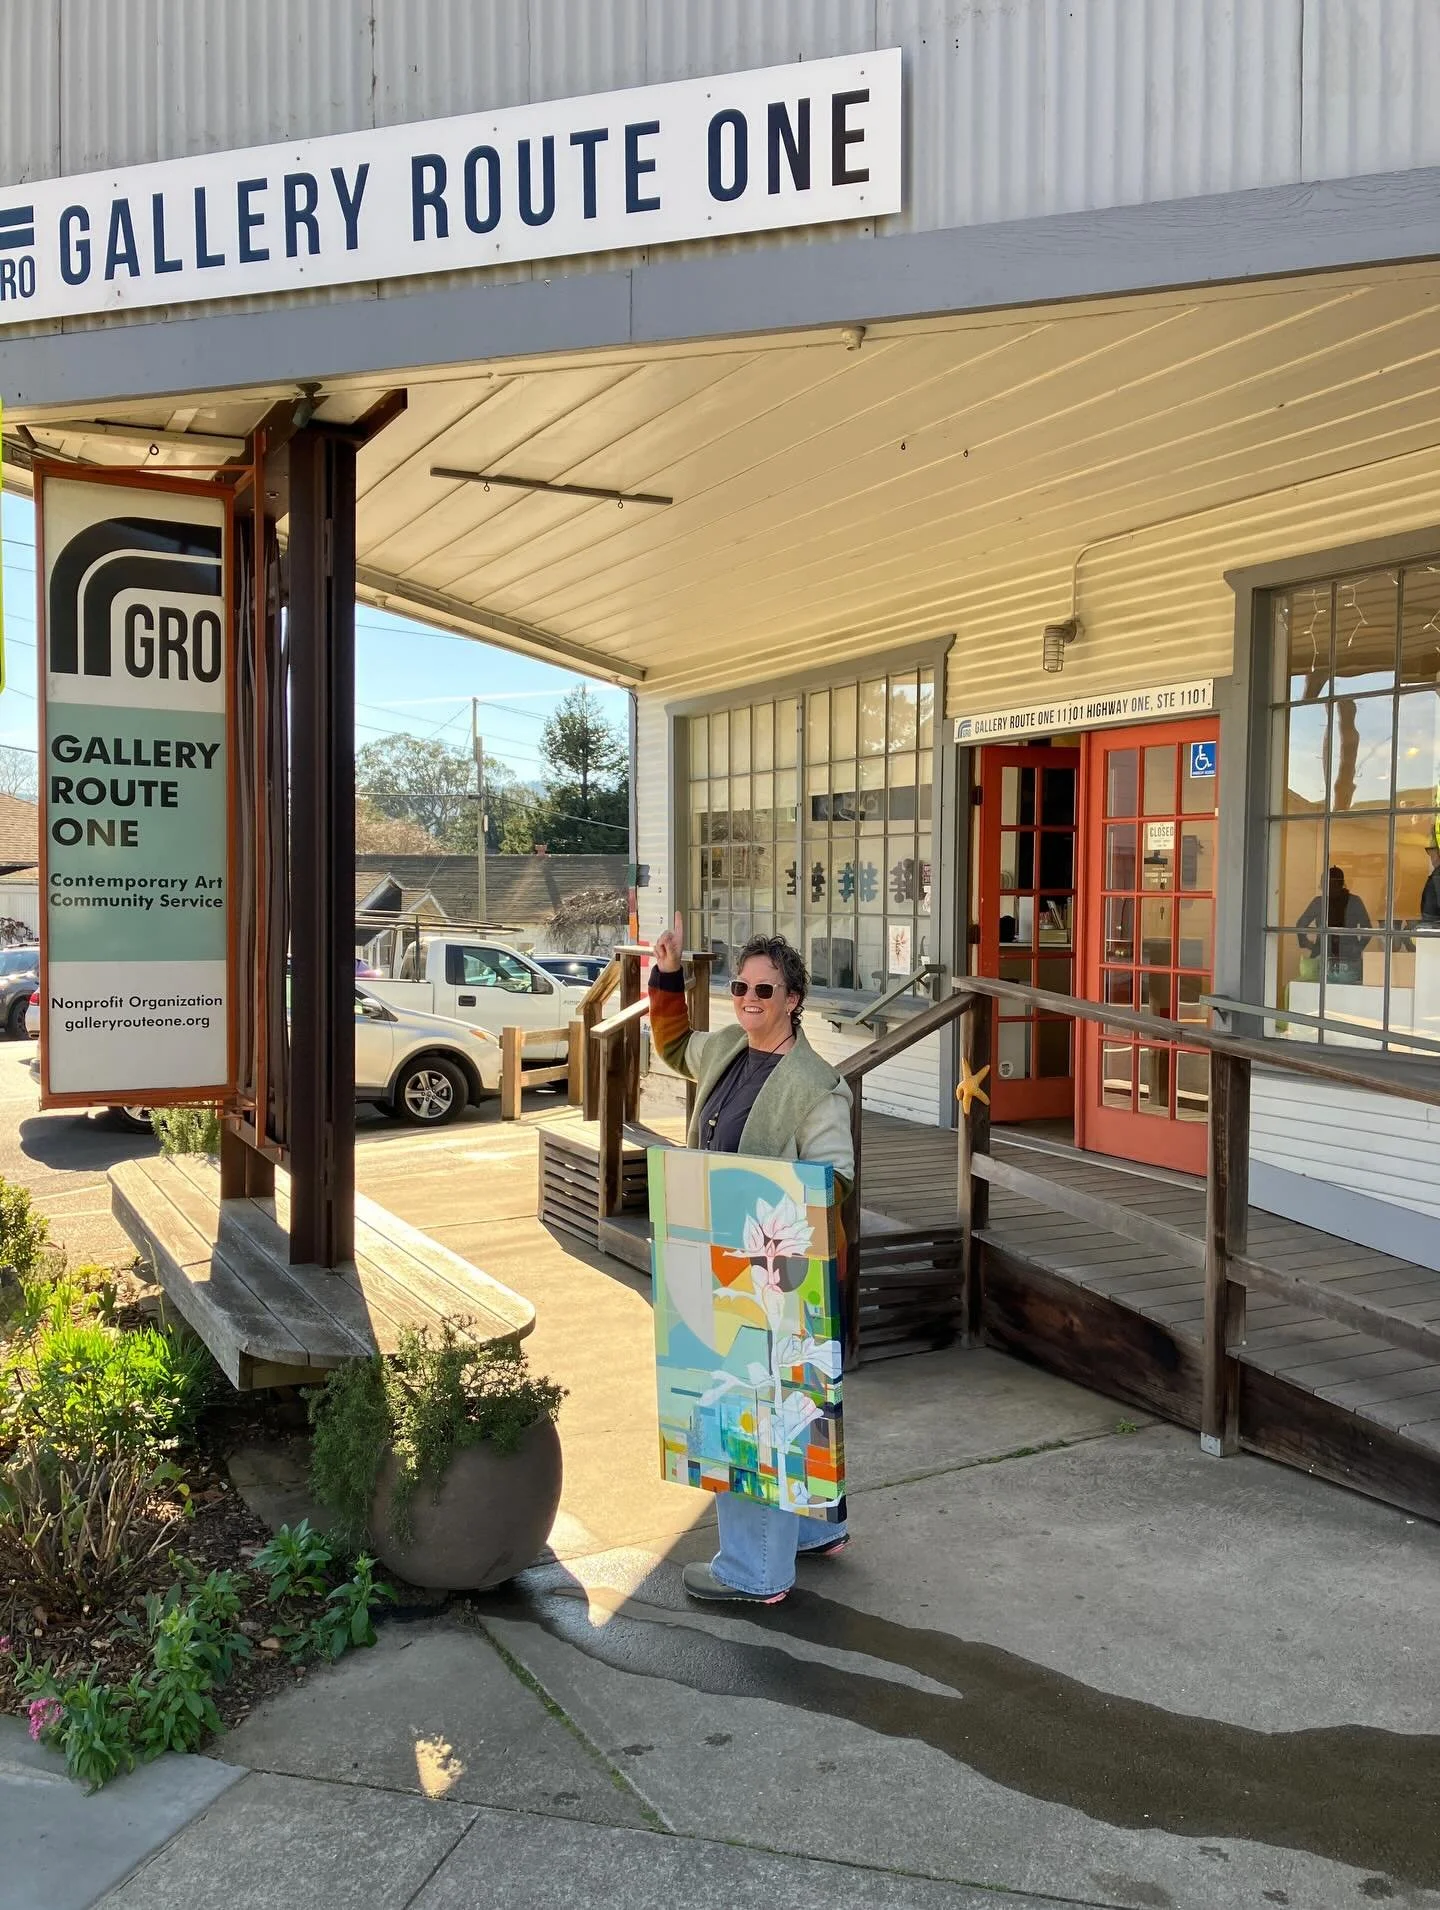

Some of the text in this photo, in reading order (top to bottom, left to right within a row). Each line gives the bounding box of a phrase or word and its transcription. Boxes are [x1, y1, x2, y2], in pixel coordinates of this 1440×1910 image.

[60, 88, 870, 285] GALLERY ROUTE ONE
[124, 603, 222, 683] GRO
[975, 688, 1206, 734] GALLERY ROUTE ONE 11101 HIGHWAY ONE, STE 1101
[51, 734, 222, 770] GALLERY
[51, 775, 179, 808] ROUTE
[51, 817, 139, 848] ONE
[1149, 826, 1174, 838] CLOSED
[50, 872, 224, 891] Contemporary Art
[50, 893, 224, 910] Community Service
[51, 994, 223, 1011] Nonprofit Organization
[64, 1016, 210, 1032] galleryrouteone.org
